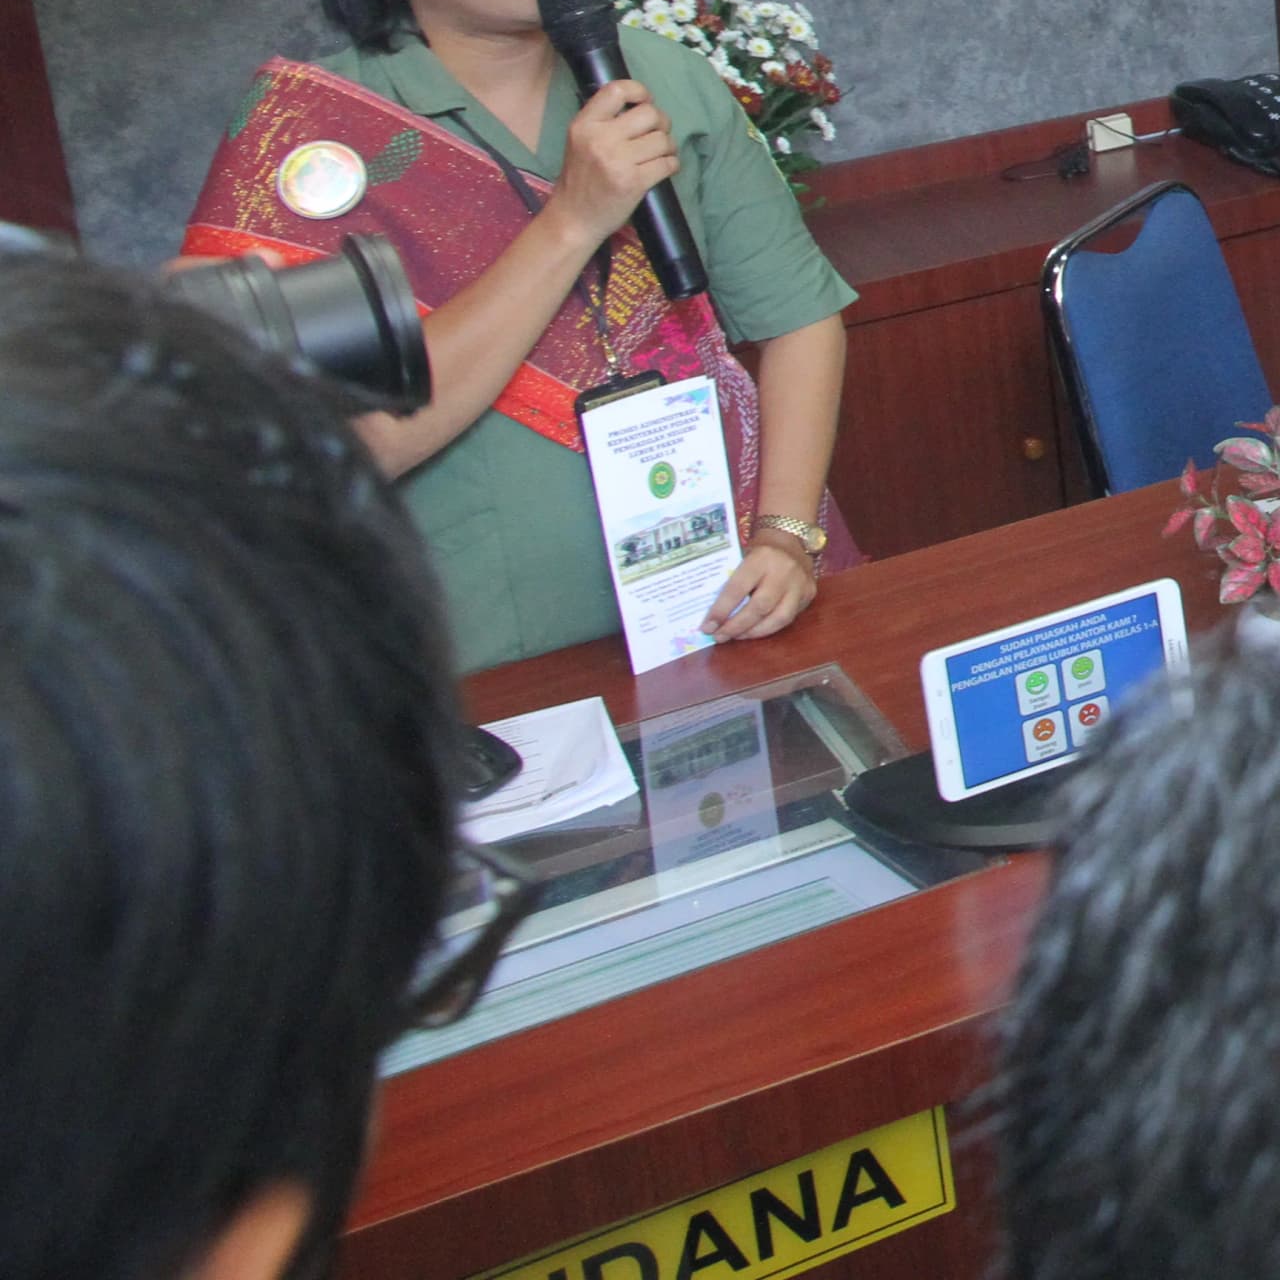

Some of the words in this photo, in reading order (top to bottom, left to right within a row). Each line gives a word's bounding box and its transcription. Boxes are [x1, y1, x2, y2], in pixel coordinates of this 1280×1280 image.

[951, 666, 1012, 691] PENGADILAN
[1013, 655, 1047, 671] NEGERI
[1048, 644, 1079, 660] LUBUK
[1080, 634, 1112, 650] PAKAM
[1113, 624, 1141, 639] KELAS
[970, 655, 1012, 673] DENGAN
[1013, 637, 1067, 660] PELAYANAN
[1067, 624, 1106, 642] KANTOR
[1106, 616, 1131, 630] KAMI
[999, 636, 1033, 653] SUDAH
[1034, 622, 1078, 642] PUASKAH
[1078, 613, 1106, 628] ANDA
